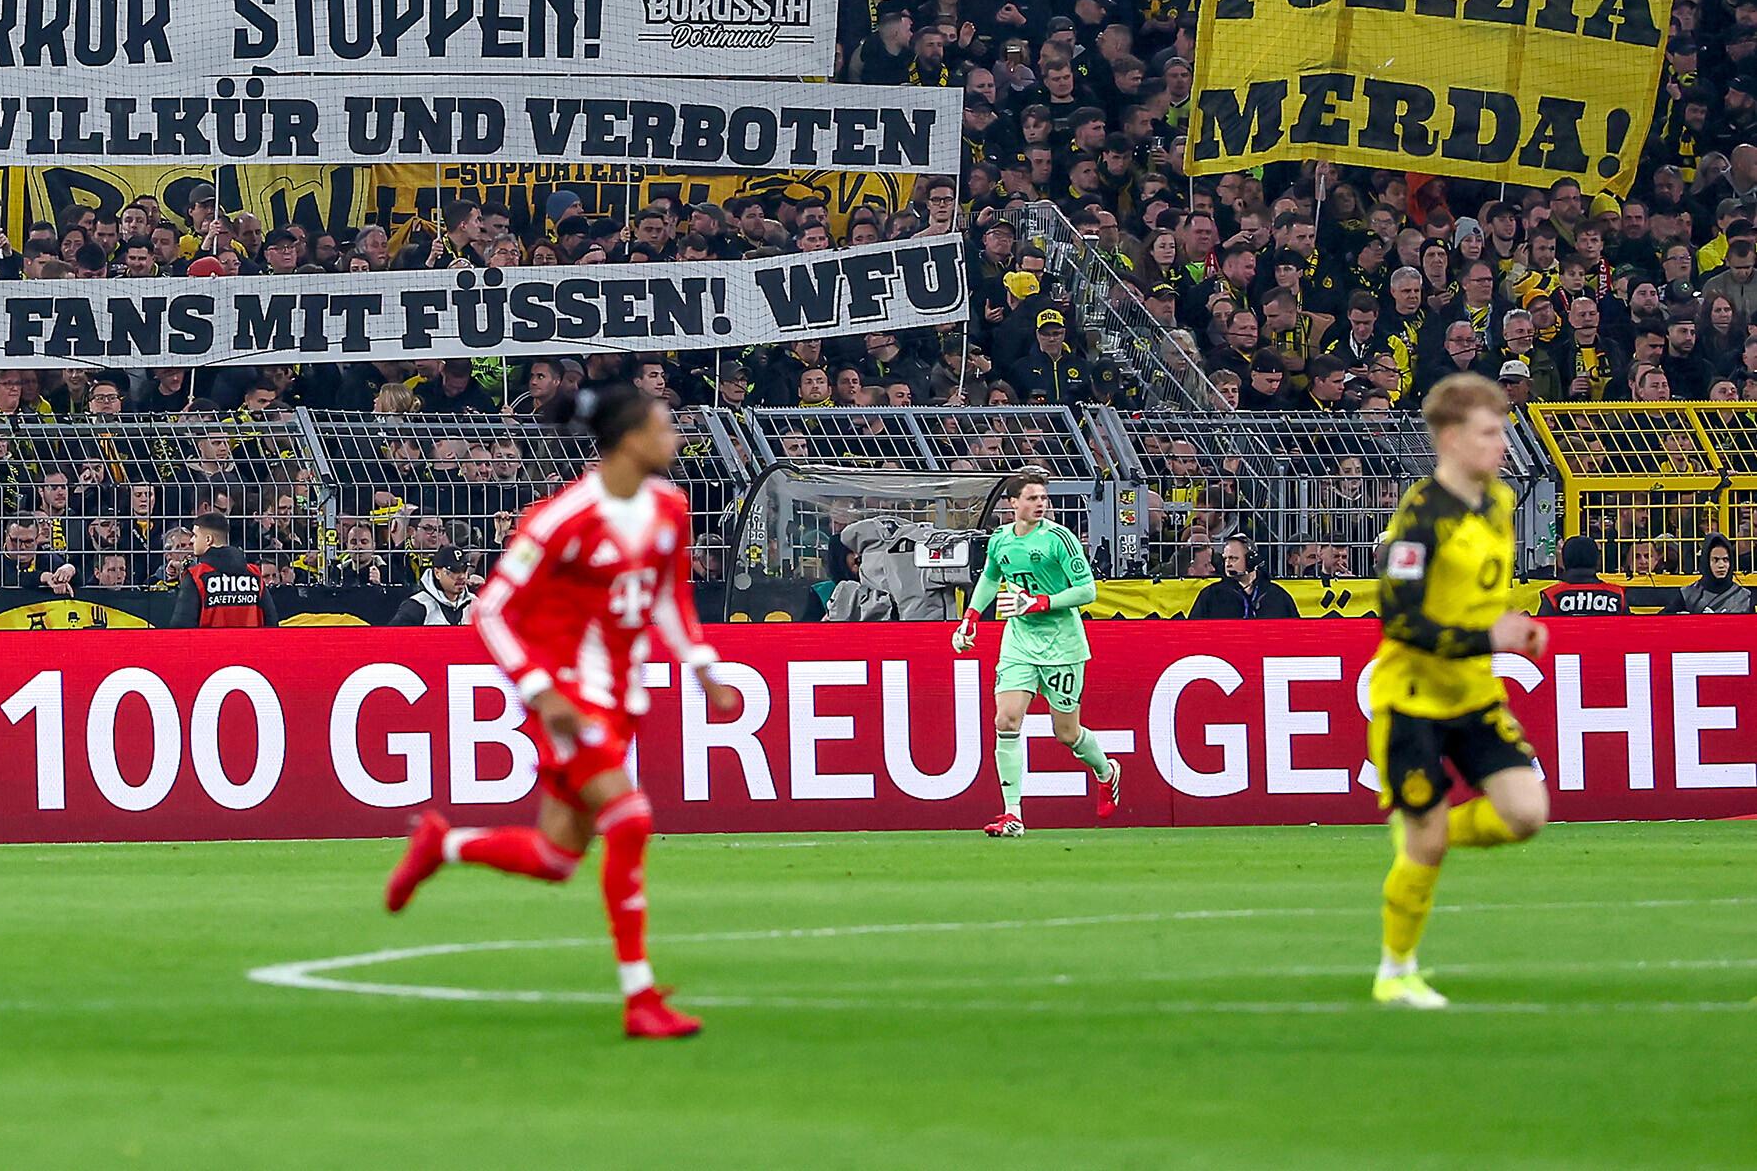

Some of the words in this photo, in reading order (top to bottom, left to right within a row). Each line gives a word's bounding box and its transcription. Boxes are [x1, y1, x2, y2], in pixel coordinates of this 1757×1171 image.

[671, 23, 781, 50] Dortmund
[344, 96, 505, 158] UND
[525, 96, 937, 166] VERBOTEN
[1193, 73, 1631, 179] MERDA!
[5, 294, 214, 356] FANS
[234, 294, 382, 353] MIT
[400, 267, 732, 350] FÜSSEN!
[756, 244, 965, 331] WFU
[207, 574, 260, 594] atlas
[1560, 594, 1618, 613] atlas
[1048, 673, 1075, 694] 40
[0, 665, 285, 812] 100
[329, 663, 540, 807] GB
